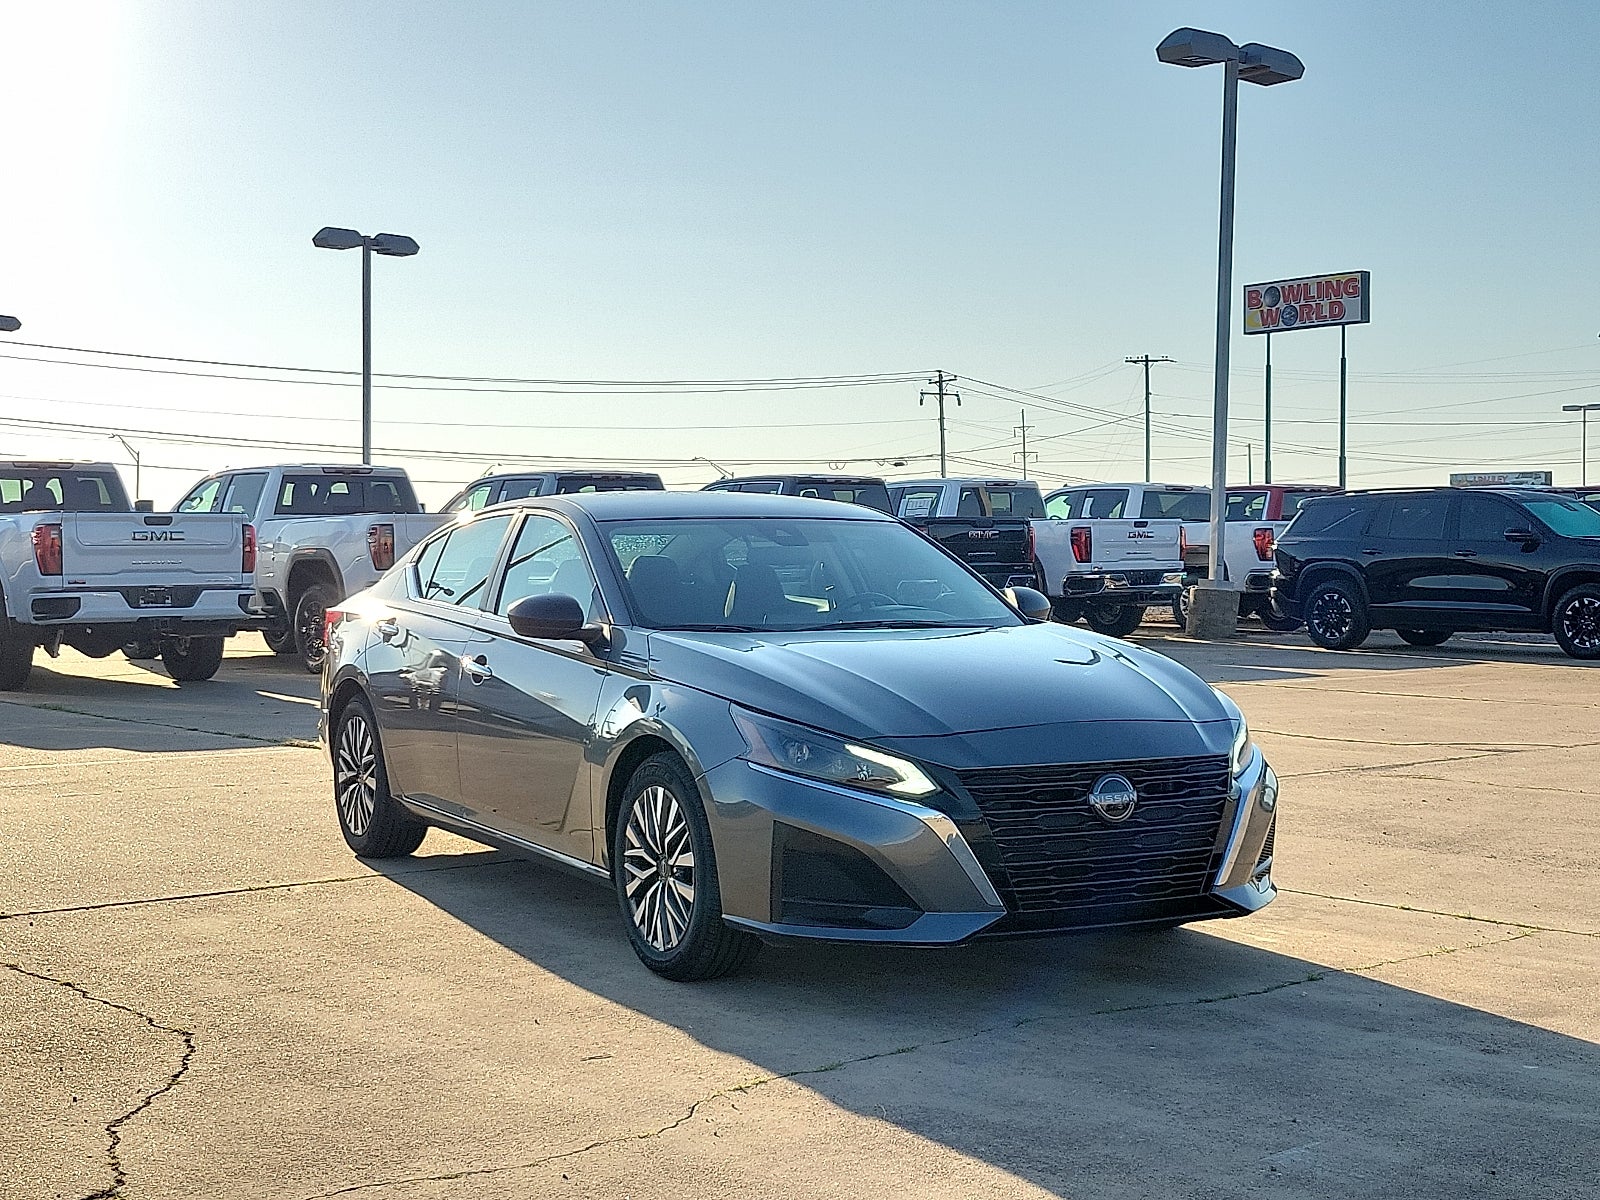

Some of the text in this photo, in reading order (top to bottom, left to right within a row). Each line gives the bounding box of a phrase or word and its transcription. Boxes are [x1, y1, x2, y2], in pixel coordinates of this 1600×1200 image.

[1247, 277, 1360, 309] BOWLING
[1259, 300, 1346, 328] WORLD
[131, 530, 186, 541] GMC
[1127, 530, 1154, 539] GMC
[1090, 793, 1137, 804] NISSAN
